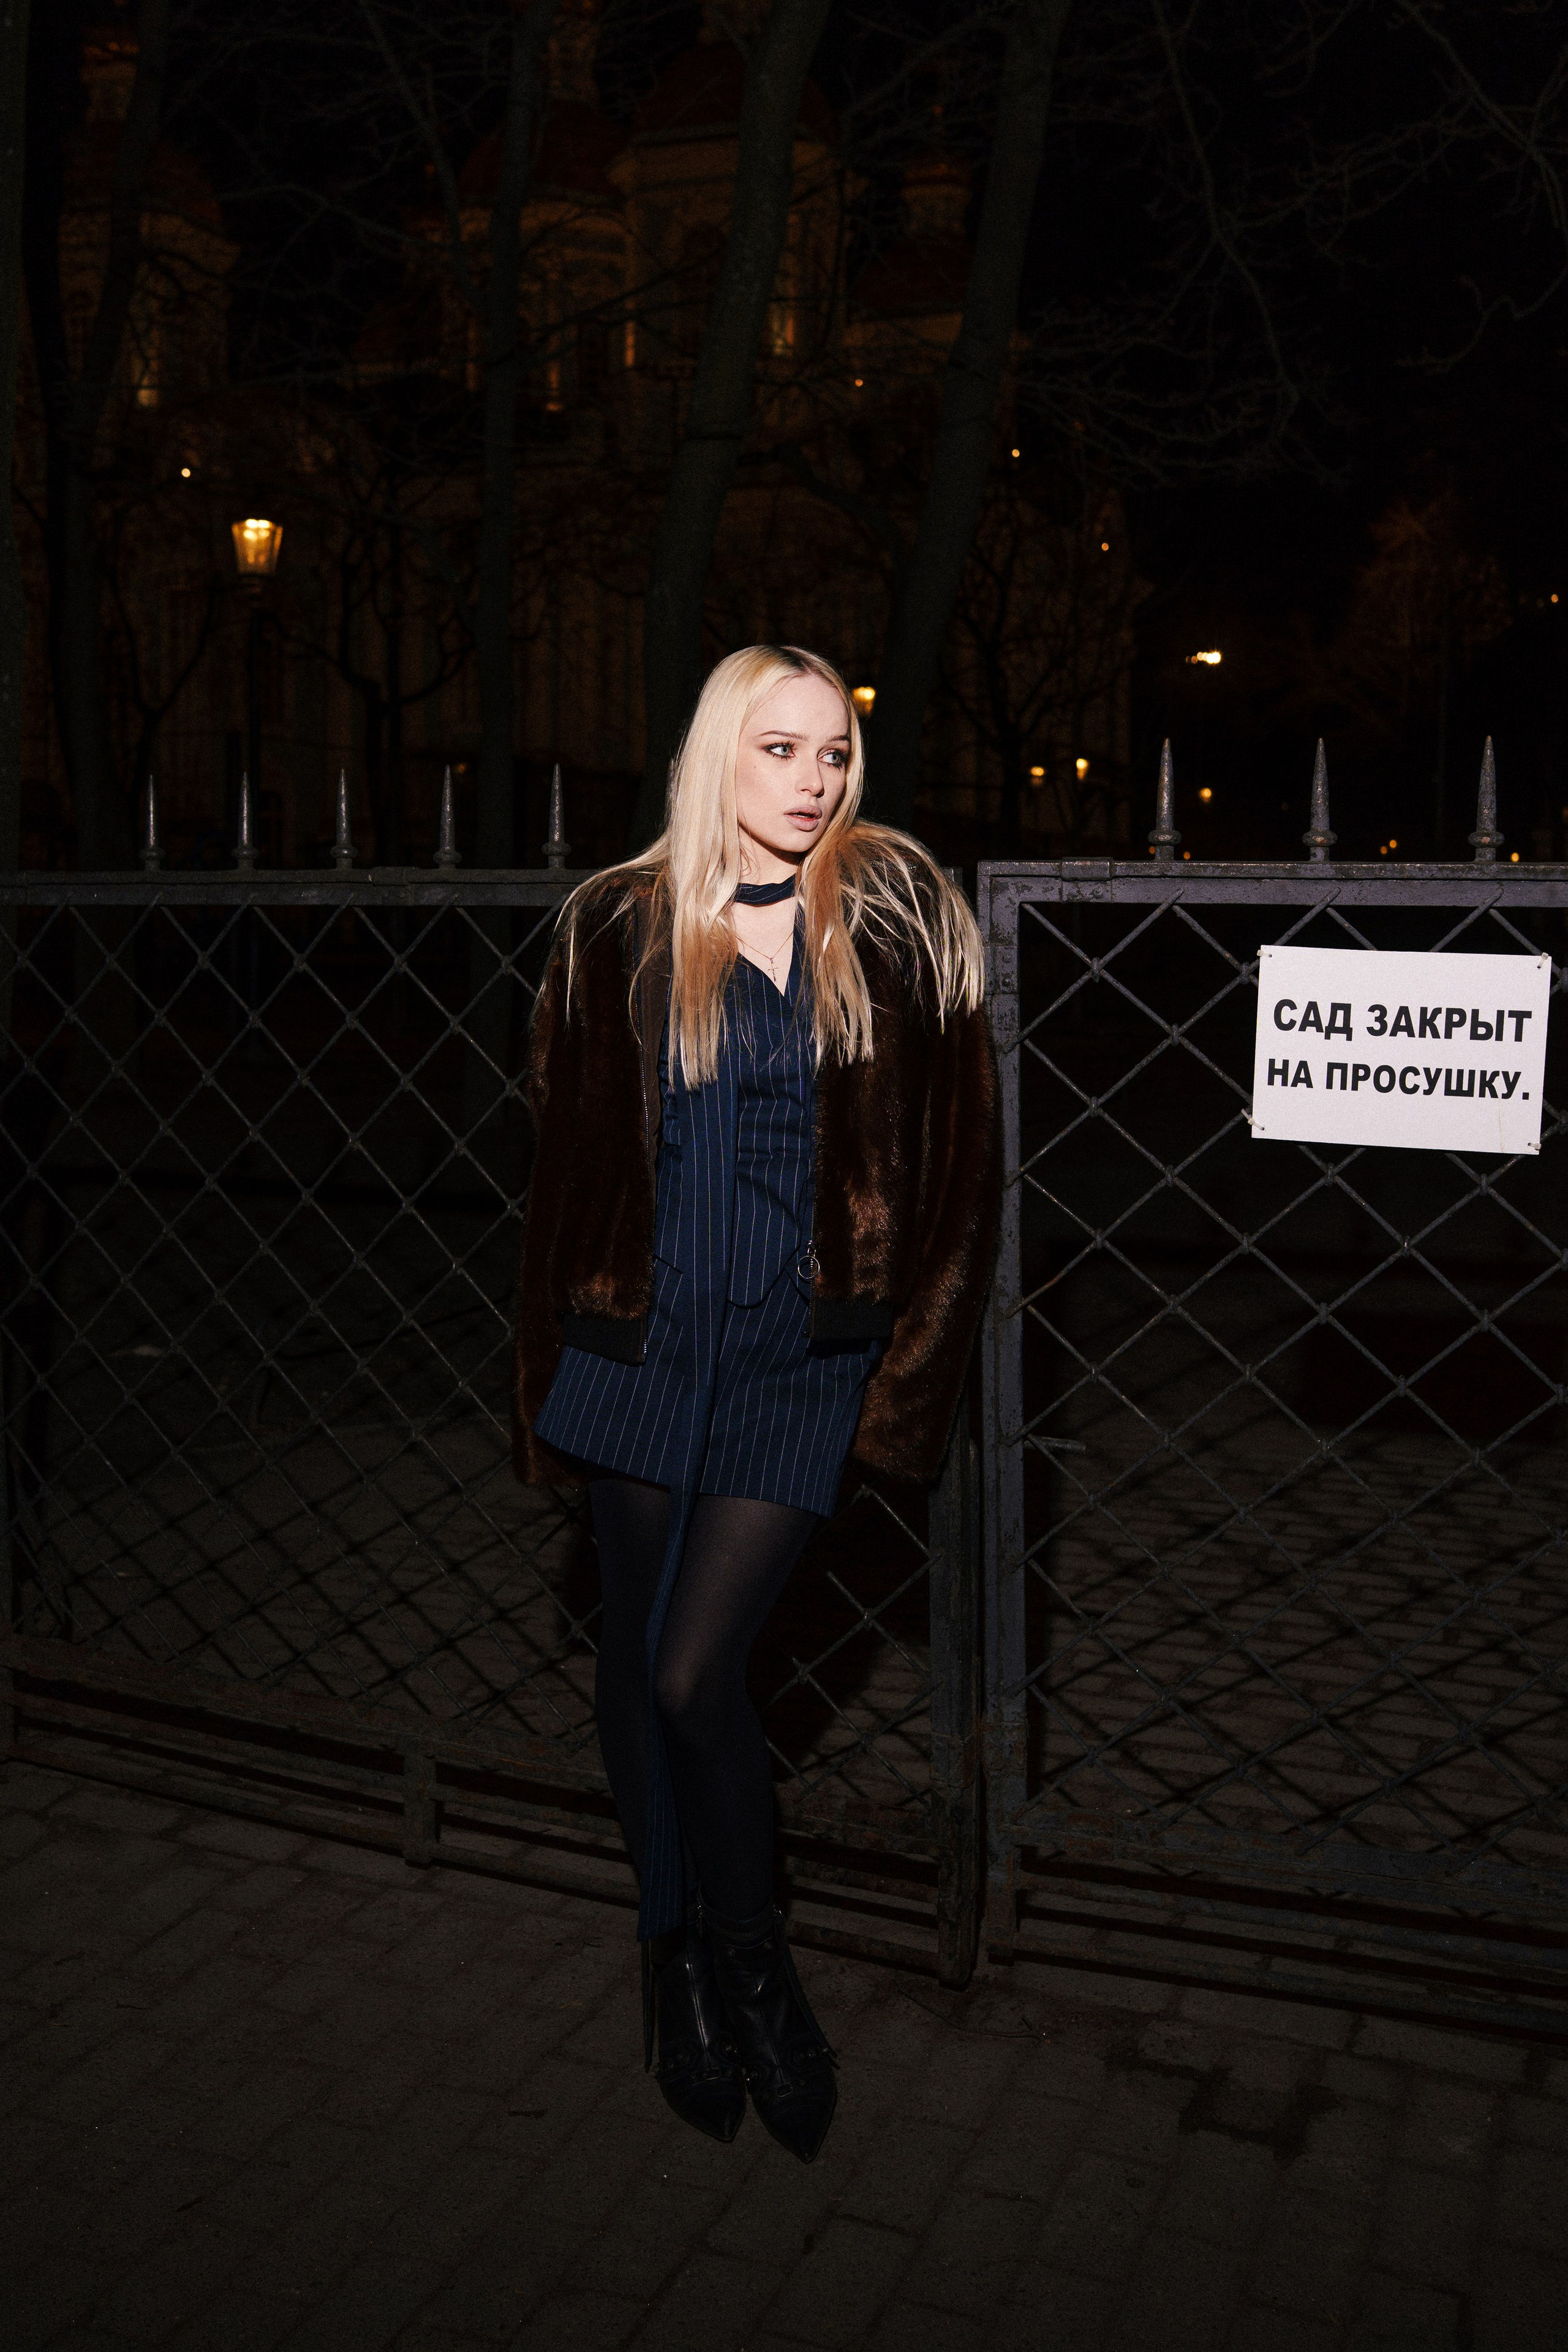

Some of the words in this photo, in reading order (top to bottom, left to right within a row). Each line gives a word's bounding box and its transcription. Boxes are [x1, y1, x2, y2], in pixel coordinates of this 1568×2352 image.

[1273, 998, 1353, 1042] САД
[1366, 1004, 1532, 1042] ЗАКРЫТ
[1267, 1058, 1314, 1089] НА
[1325, 1061, 1530, 1101] ПРОСУШКУ.
